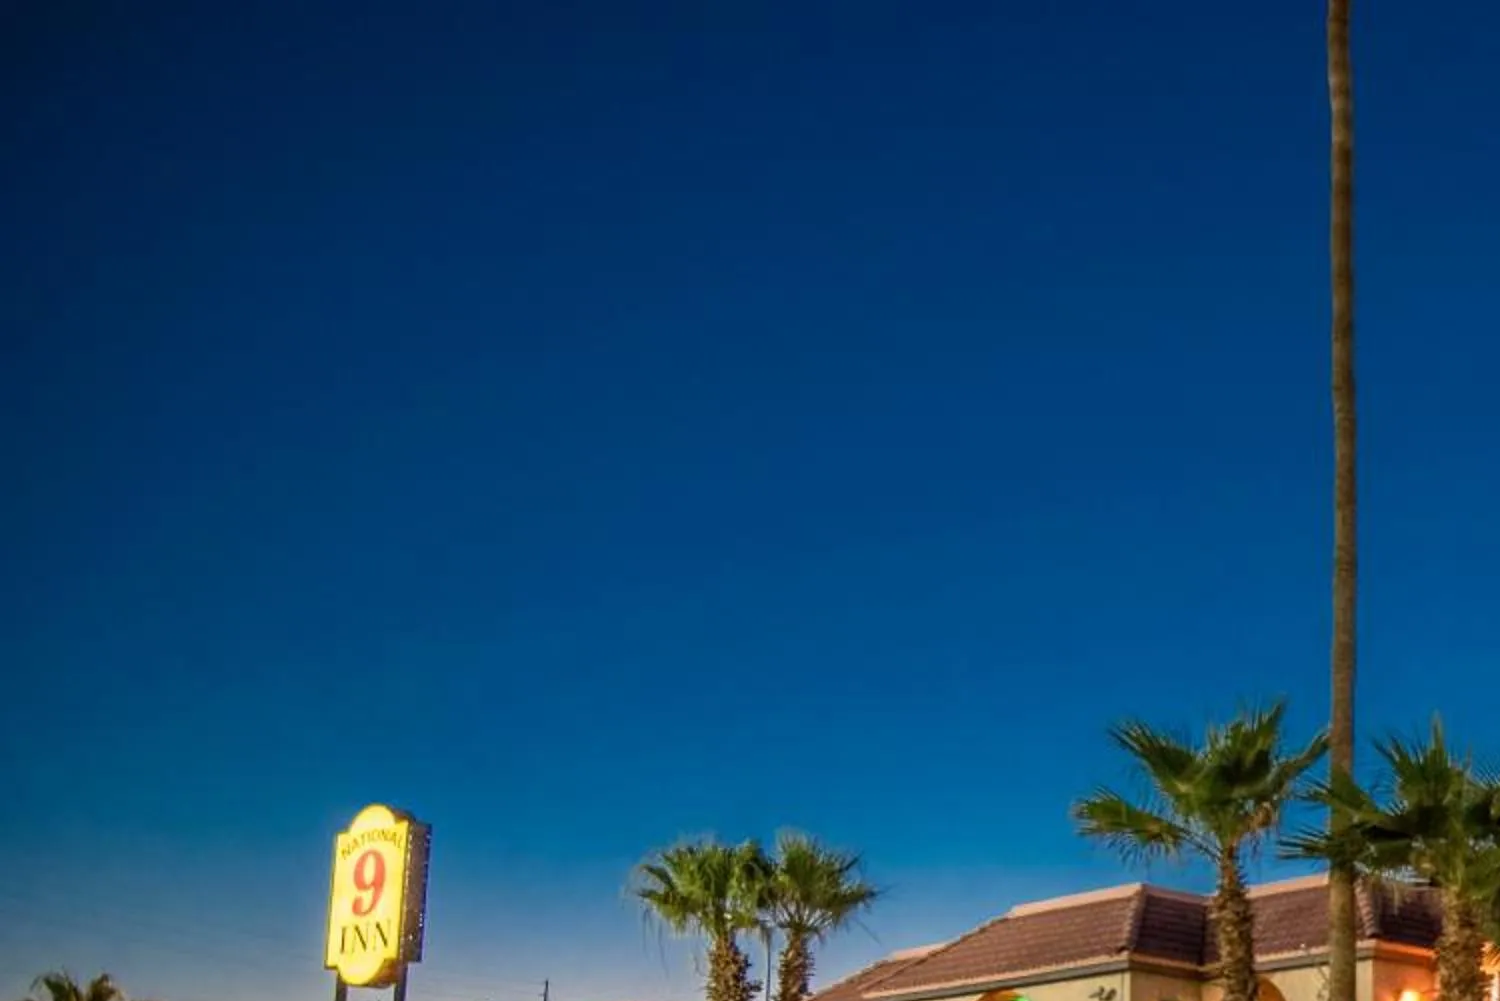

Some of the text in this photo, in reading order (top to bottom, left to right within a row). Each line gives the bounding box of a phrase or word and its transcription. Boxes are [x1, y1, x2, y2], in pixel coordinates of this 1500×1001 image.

[341, 828, 402, 860] NATIONAL
[352, 849, 386, 917] 9
[340, 919, 391, 954] INN
